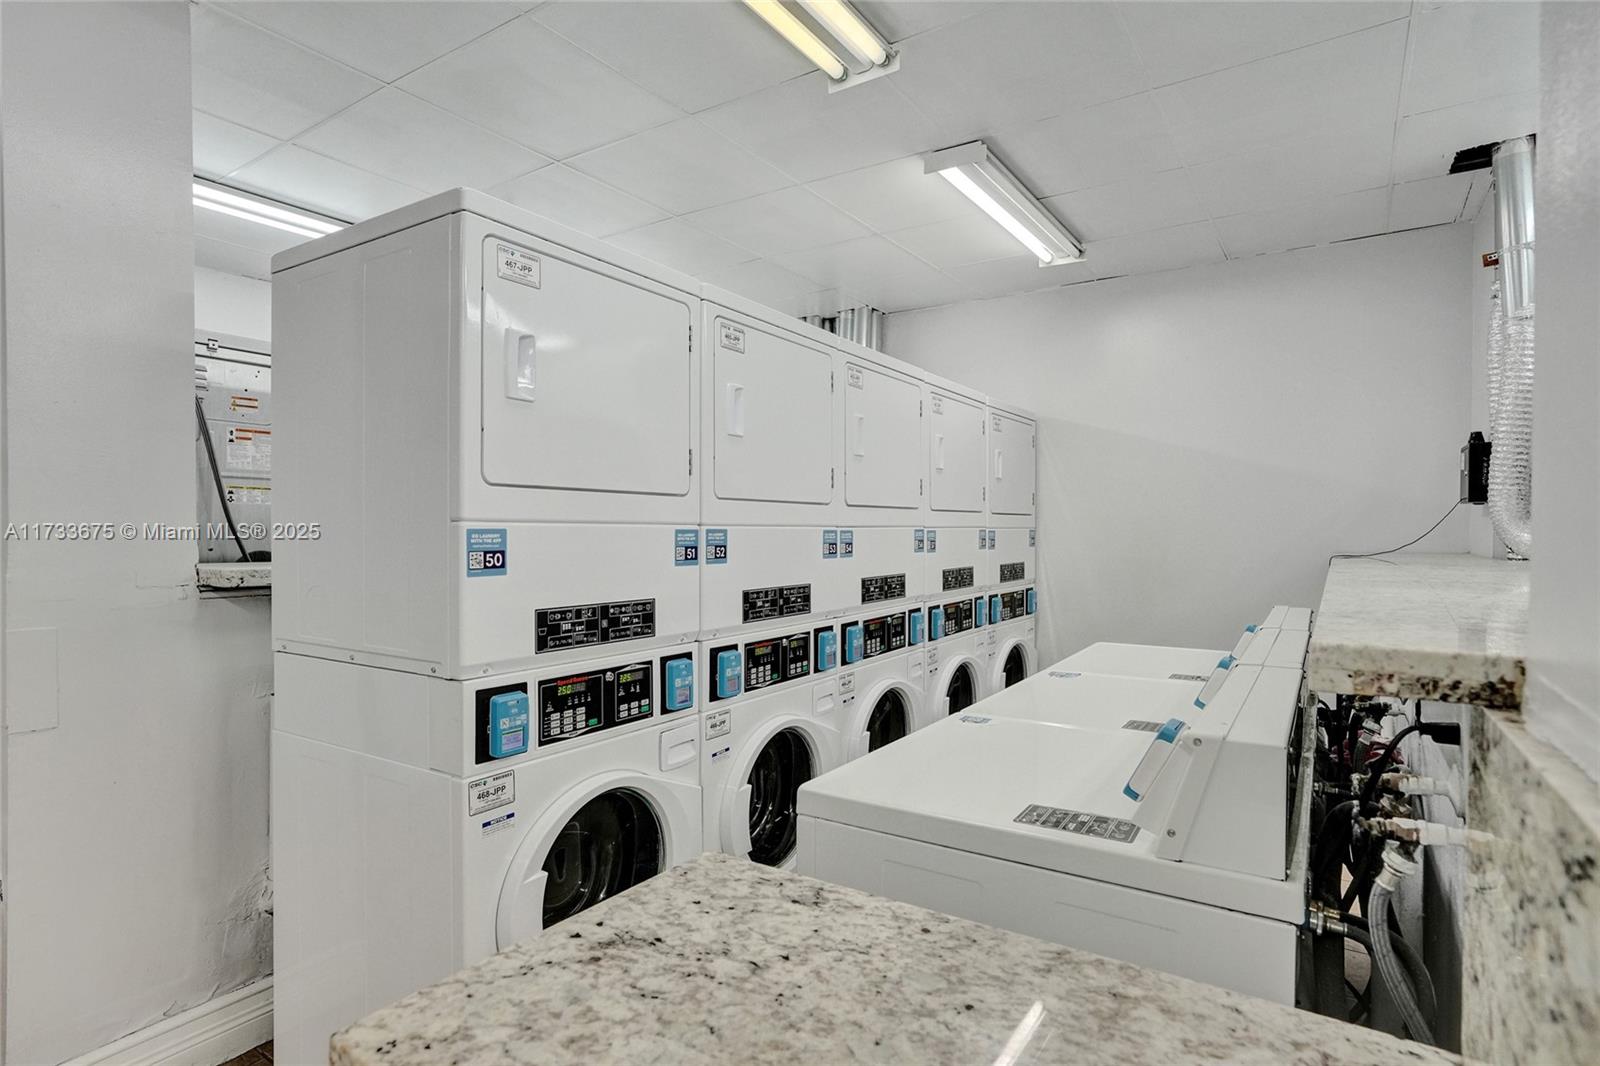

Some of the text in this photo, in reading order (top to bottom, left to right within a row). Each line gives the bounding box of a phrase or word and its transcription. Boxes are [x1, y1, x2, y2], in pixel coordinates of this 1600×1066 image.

[686, 548, 696, 559] 51
[715, 546, 726, 558] 52
[485, 552, 503, 567] 50
[477, 784, 506, 800] 468-JPP
